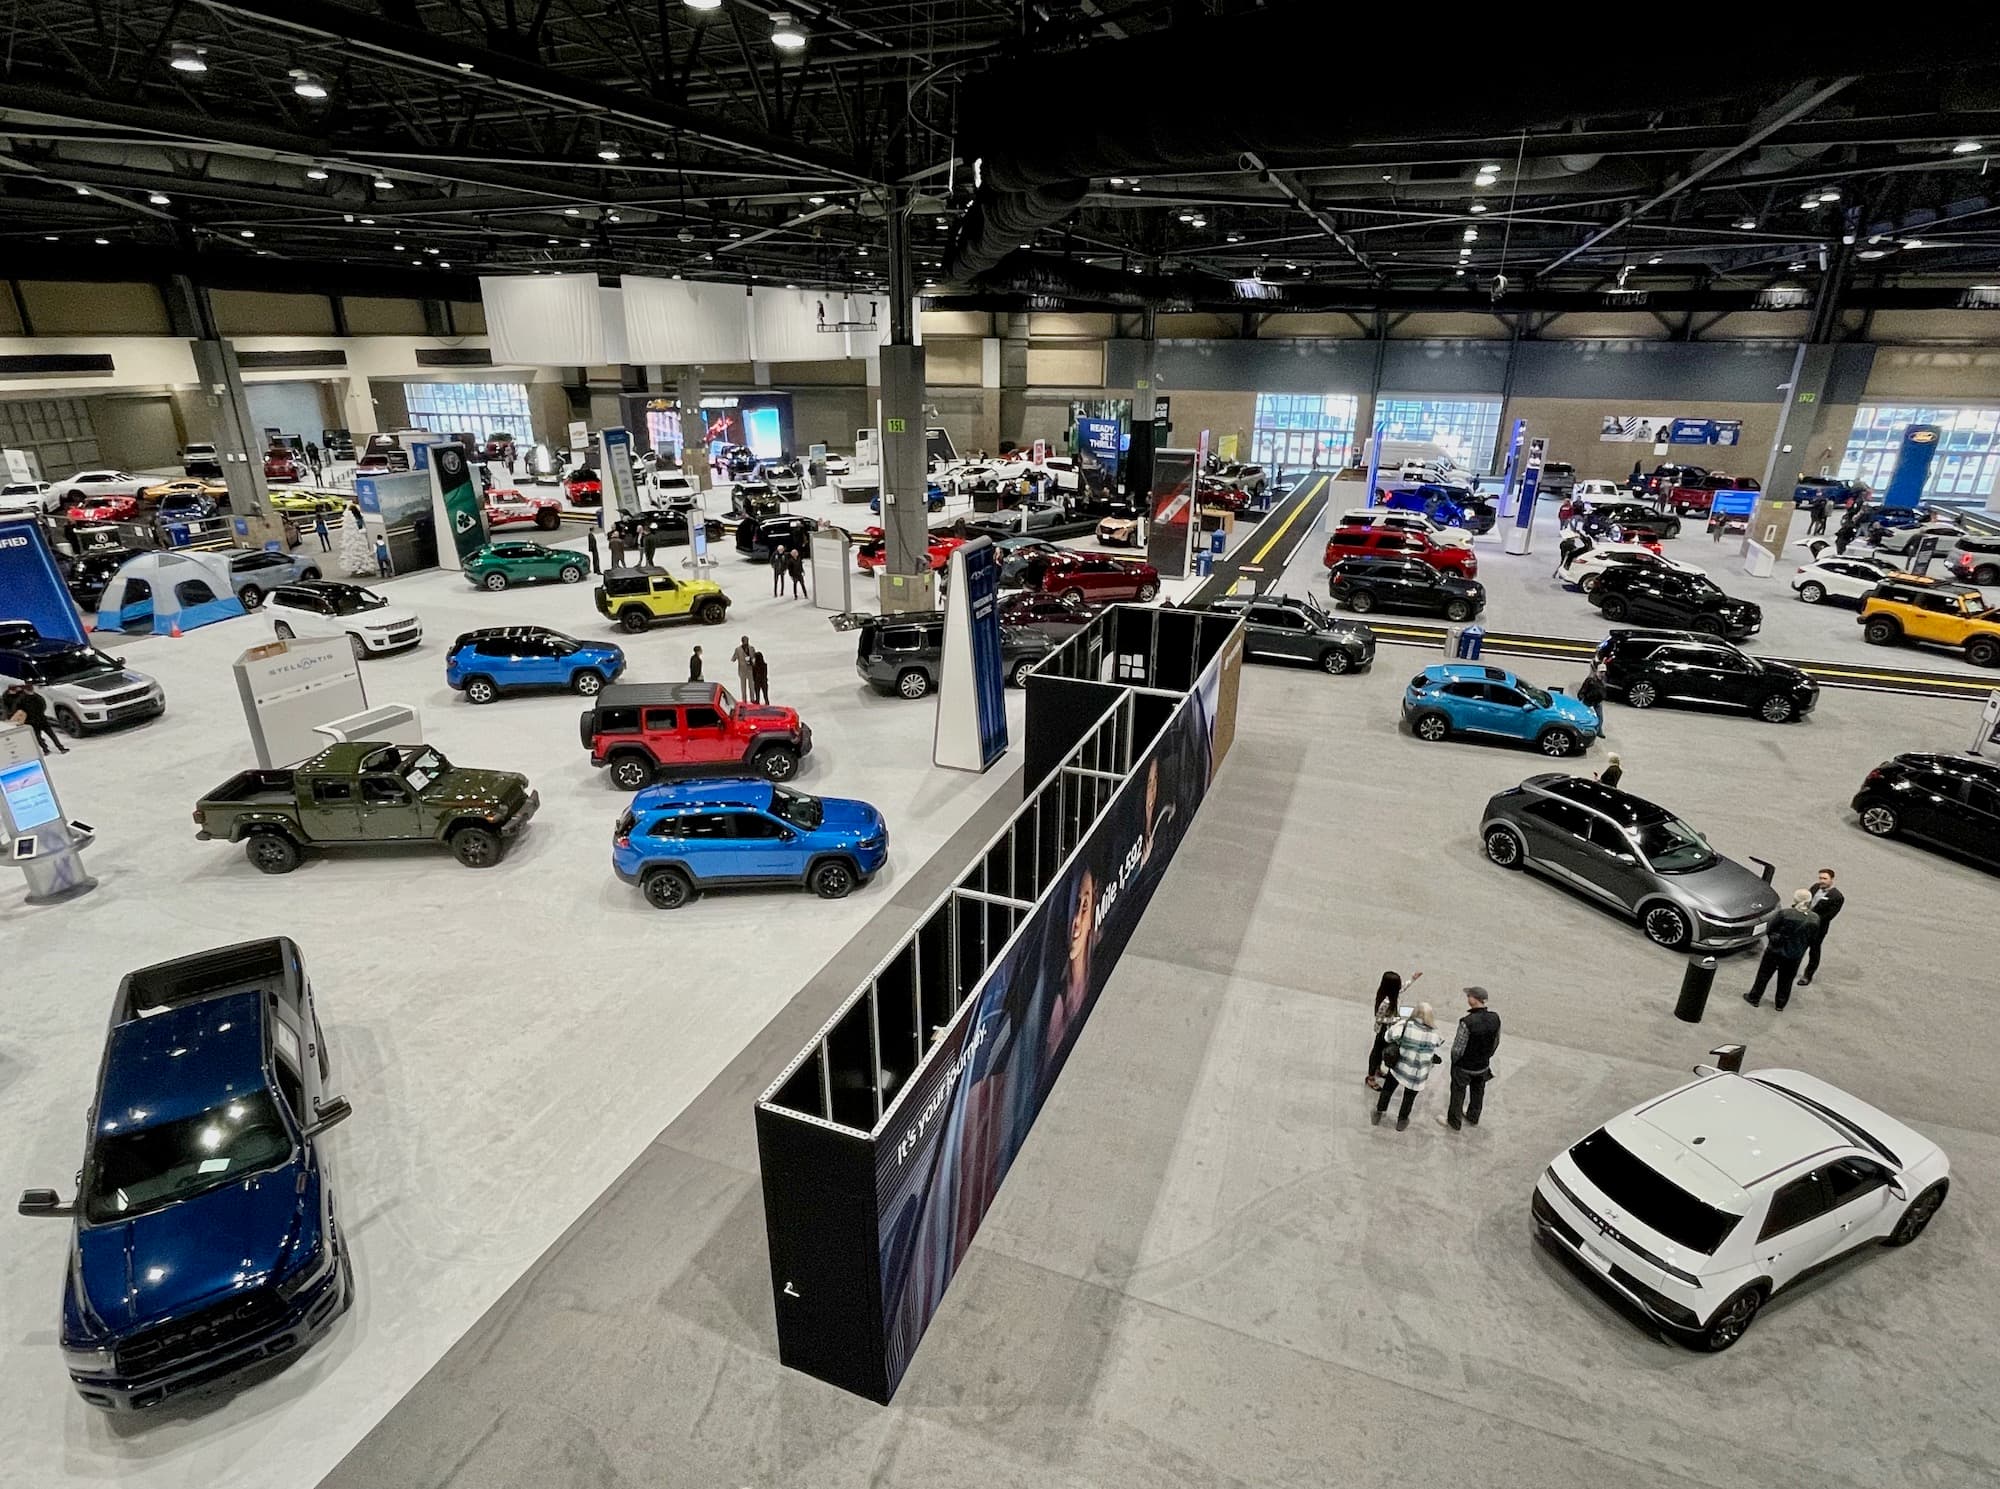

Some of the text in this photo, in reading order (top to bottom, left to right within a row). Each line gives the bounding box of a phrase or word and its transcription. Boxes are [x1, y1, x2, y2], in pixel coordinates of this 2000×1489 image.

[88, 541, 120, 550] ACURA
[268, 654, 334, 676] STELLANTIS
[1094, 833, 1143, 932] Mile 1,592
[897, 1129, 917, 1166] It's
[917, 1086, 949, 1138] your
